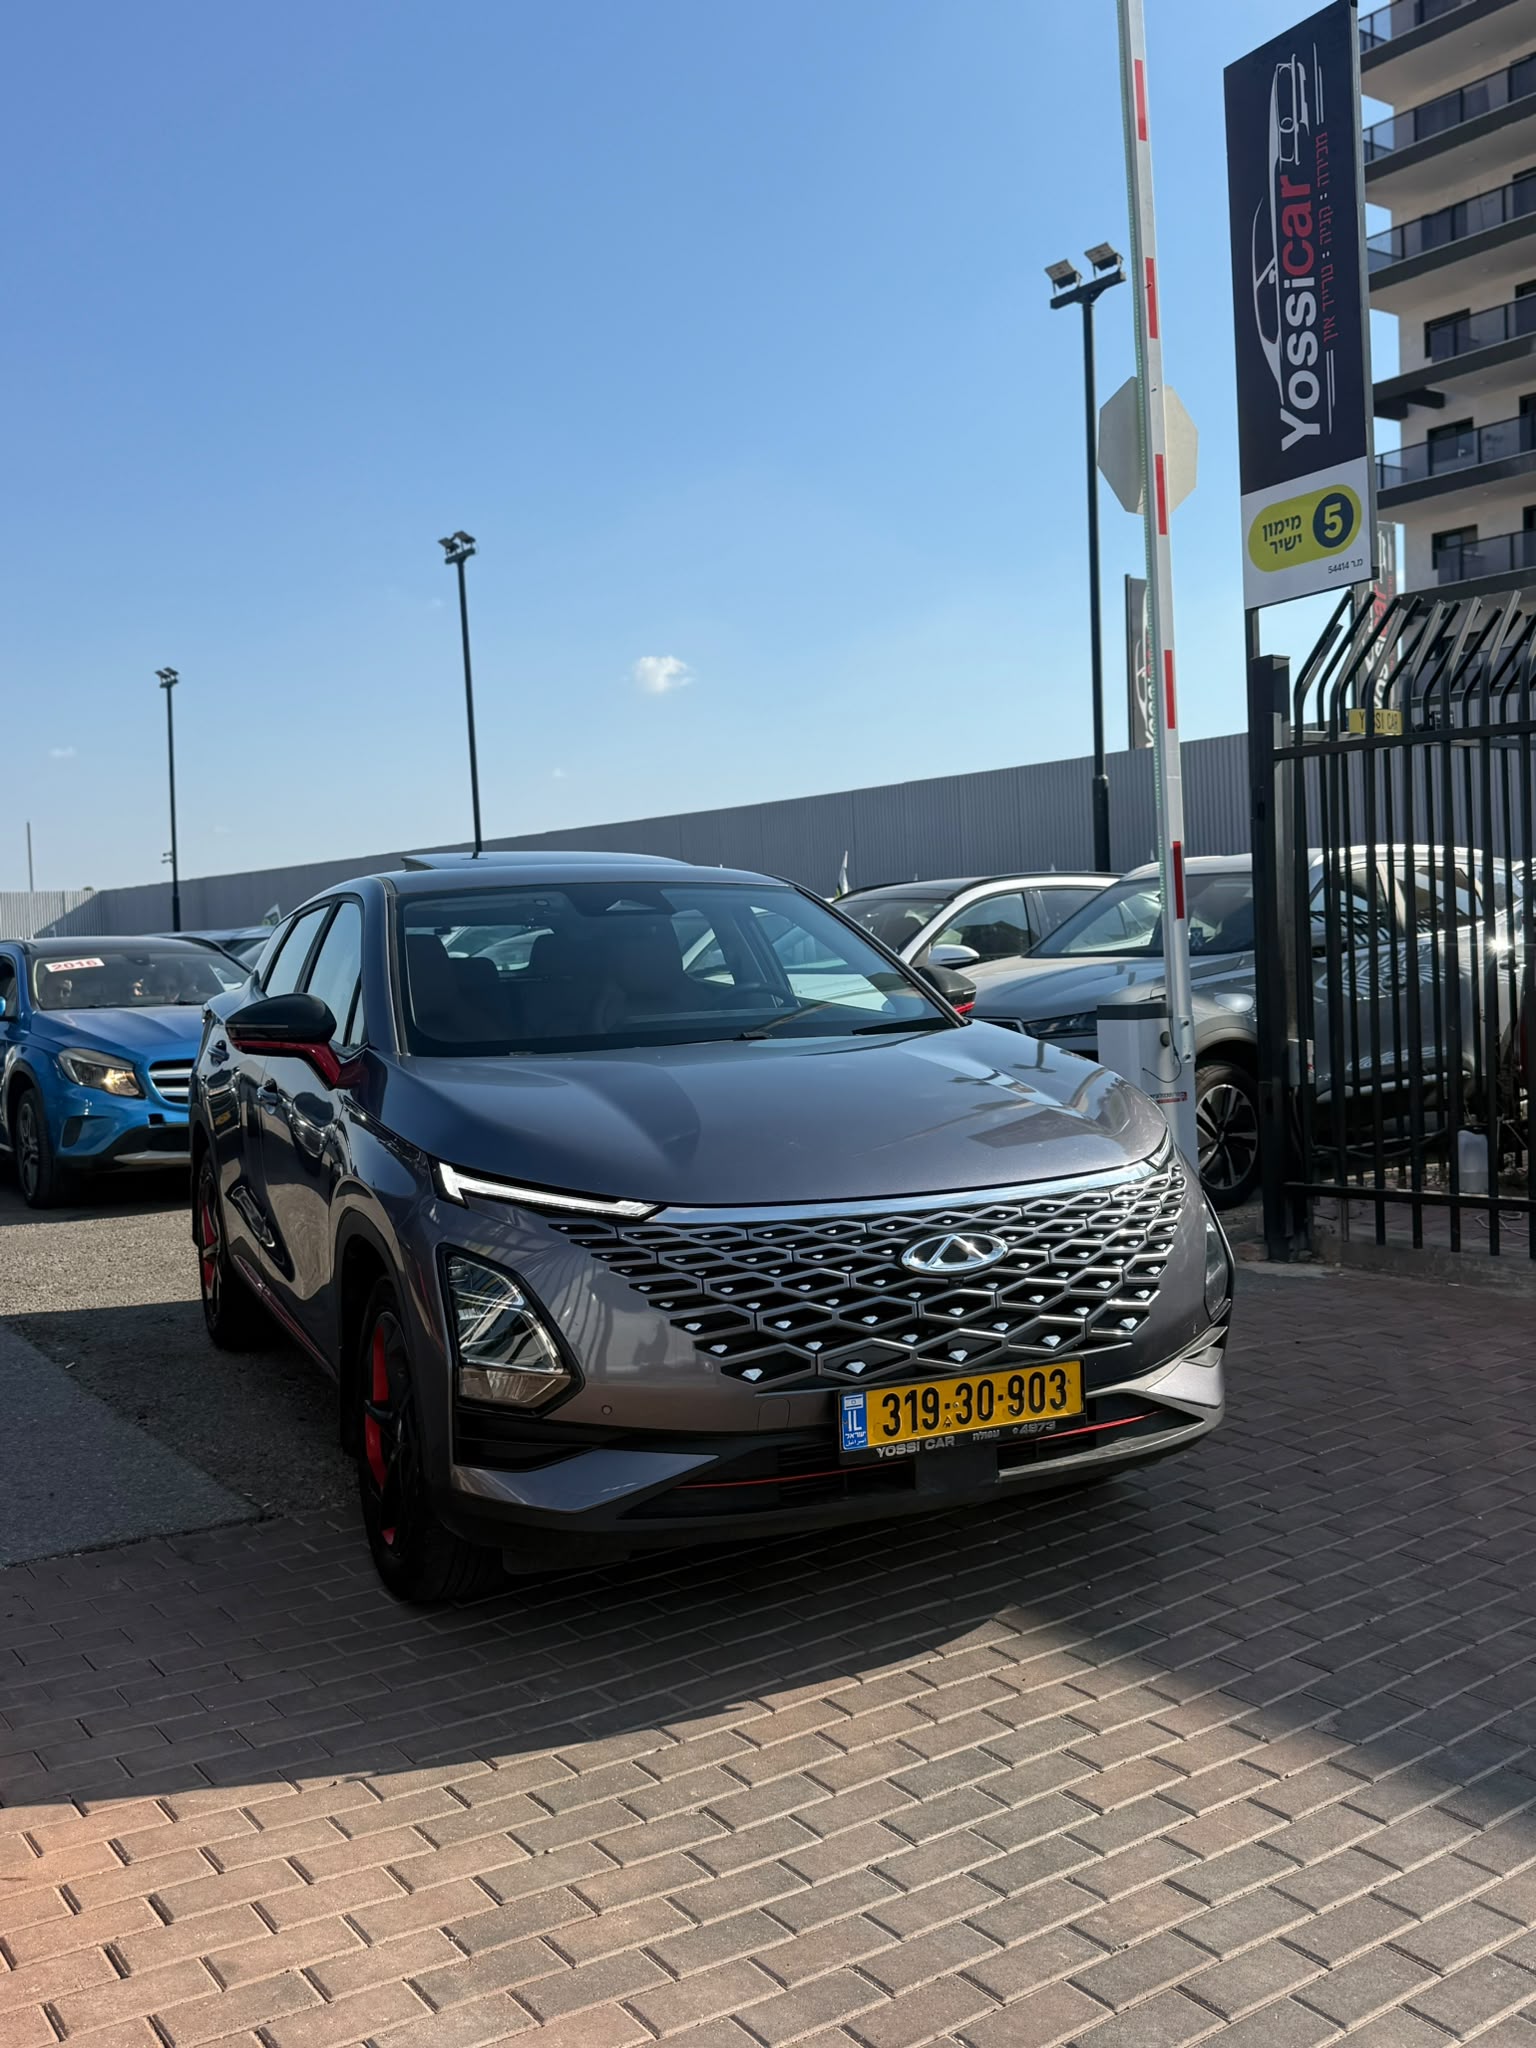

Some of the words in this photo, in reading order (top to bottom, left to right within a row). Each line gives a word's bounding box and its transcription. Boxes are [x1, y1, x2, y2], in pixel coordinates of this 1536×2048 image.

[1262, 514, 1302, 542] מימון
[1324, 502, 1344, 539] 5
[1269, 533, 1302, 555] ישיר
[847, 1410, 862, 1432] IL
[876, 1441, 920, 1458] YOSSI
[925, 1435, 956, 1450] CAR
